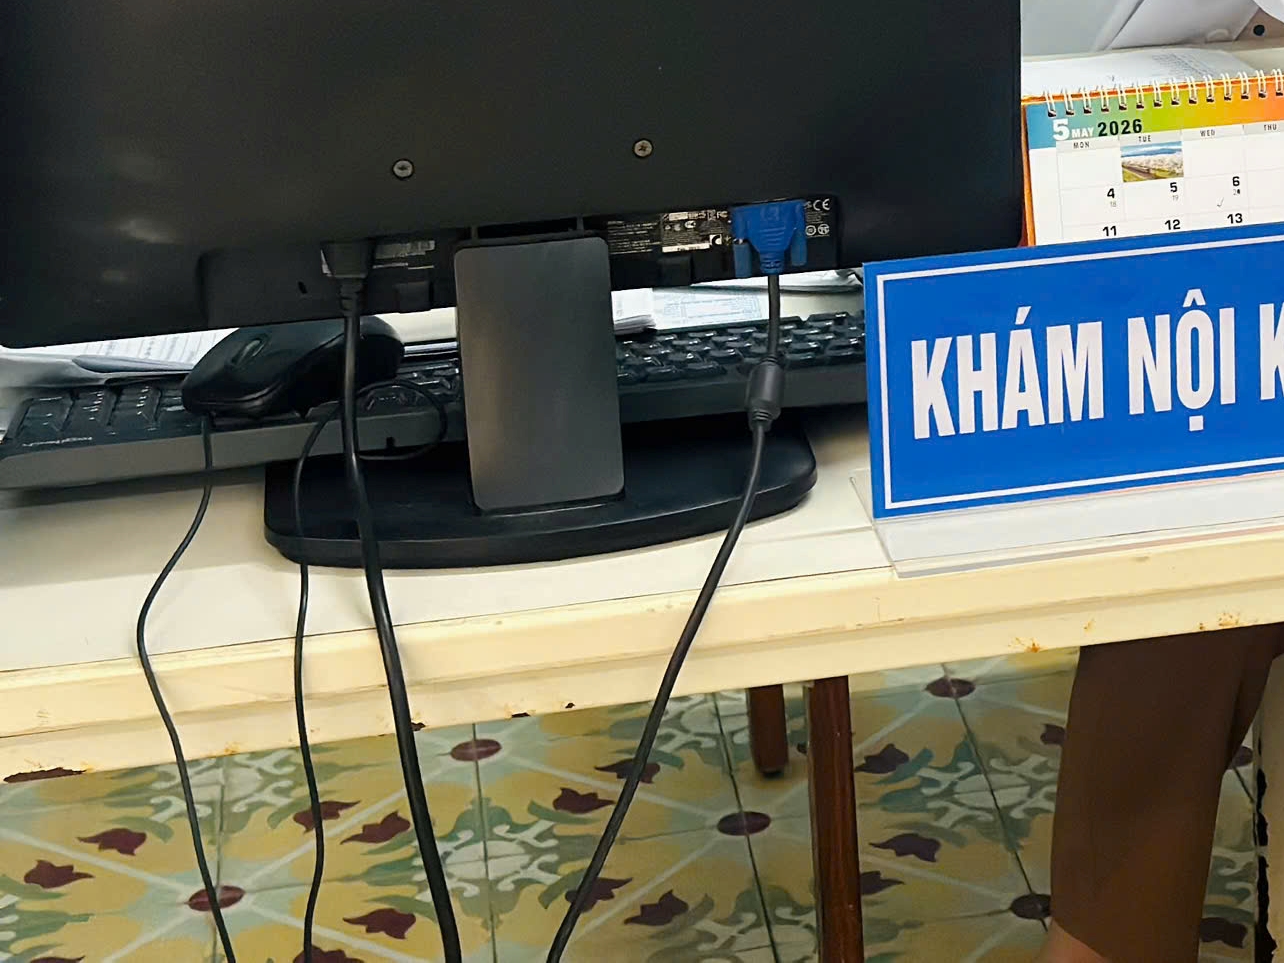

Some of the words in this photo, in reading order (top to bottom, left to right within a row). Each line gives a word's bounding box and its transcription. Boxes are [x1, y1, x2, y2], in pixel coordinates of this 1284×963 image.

[1053, 119, 1069, 140] 5
[1071, 127, 1094, 138] MAY
[1097, 118, 1142, 137] 2026
[1073, 141, 1090, 149] MON
[1138, 135, 1151, 143] TUE
[1106, 188, 1115, 198] 4
[1170, 182, 1178, 193] 5
[1232, 176, 1240, 187] 6
[1103, 225, 1117, 237] 11
[1164, 219, 1181, 230] 12
[1227, 213, 1243, 224] 13
[910, 305, 1105, 440] KHÁM
[1127, 289, 1236, 432] NỘI
